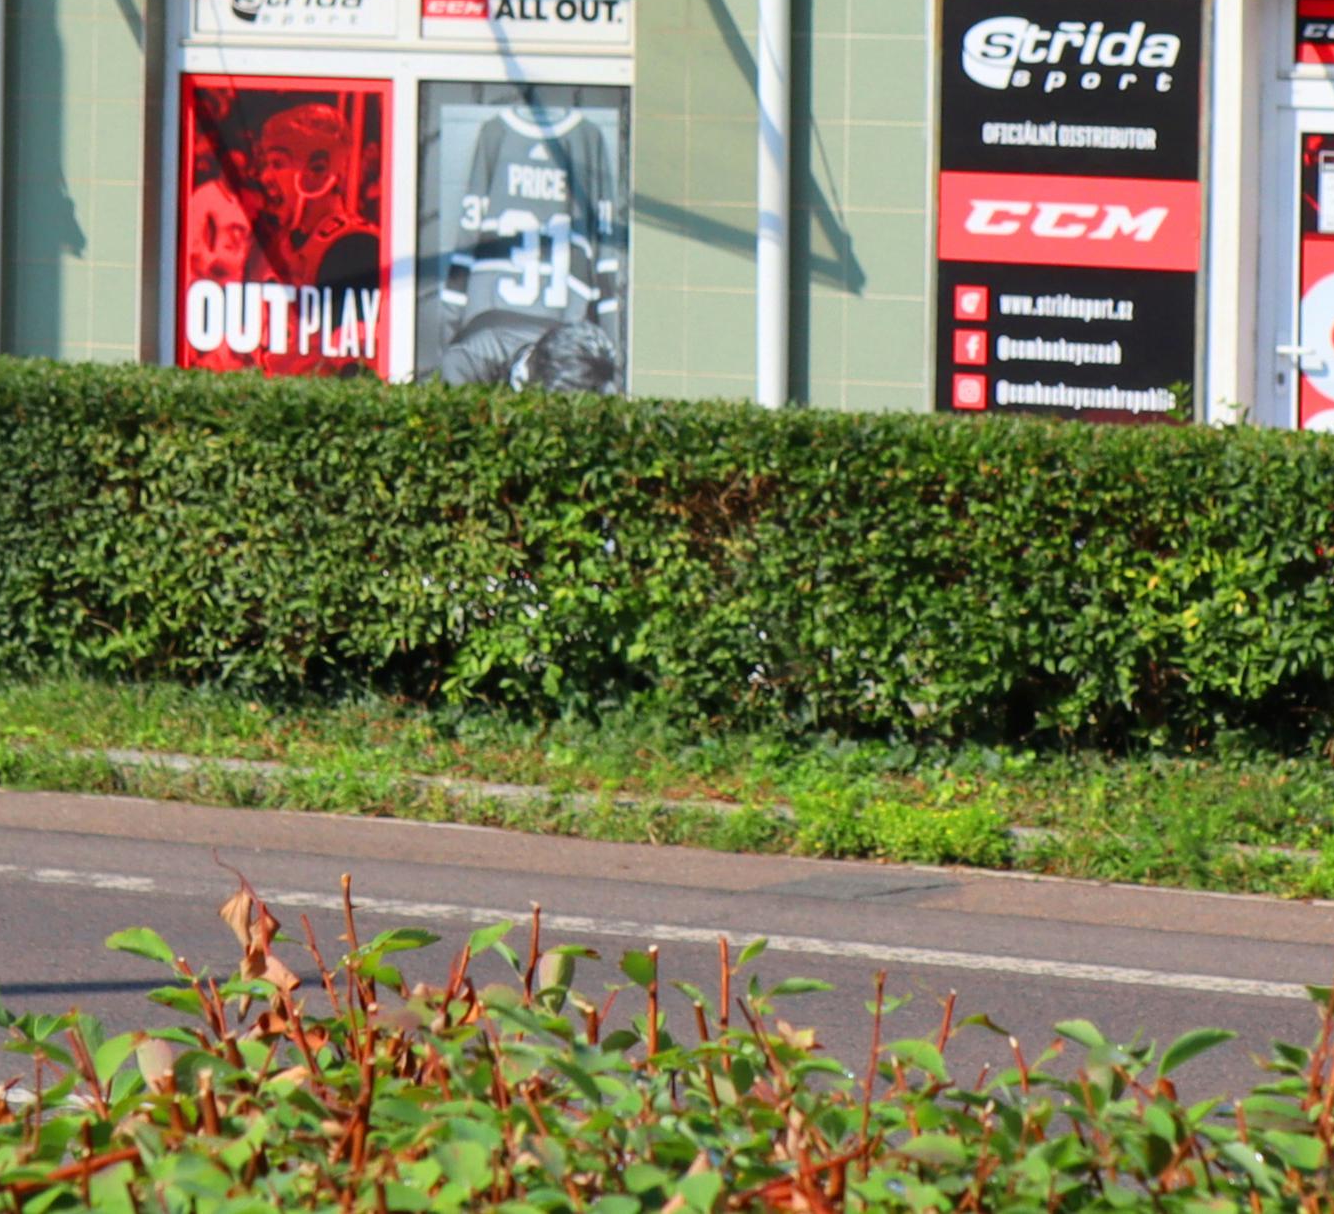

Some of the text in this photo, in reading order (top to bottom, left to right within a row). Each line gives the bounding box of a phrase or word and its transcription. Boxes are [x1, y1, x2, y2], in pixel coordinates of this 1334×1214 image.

[261, 12, 360, 26] sport
[555, 0, 623, 24] OUT.
[1011, 70, 1174, 93] sport
[1058, 123, 1157, 150] DISTRIBUTOR
[508, 162, 567, 202] PRICE
[964, 198, 1170, 242] CCM
[496, 207, 572, 308] 31
[186, 279, 381, 360] OUTPLAY
